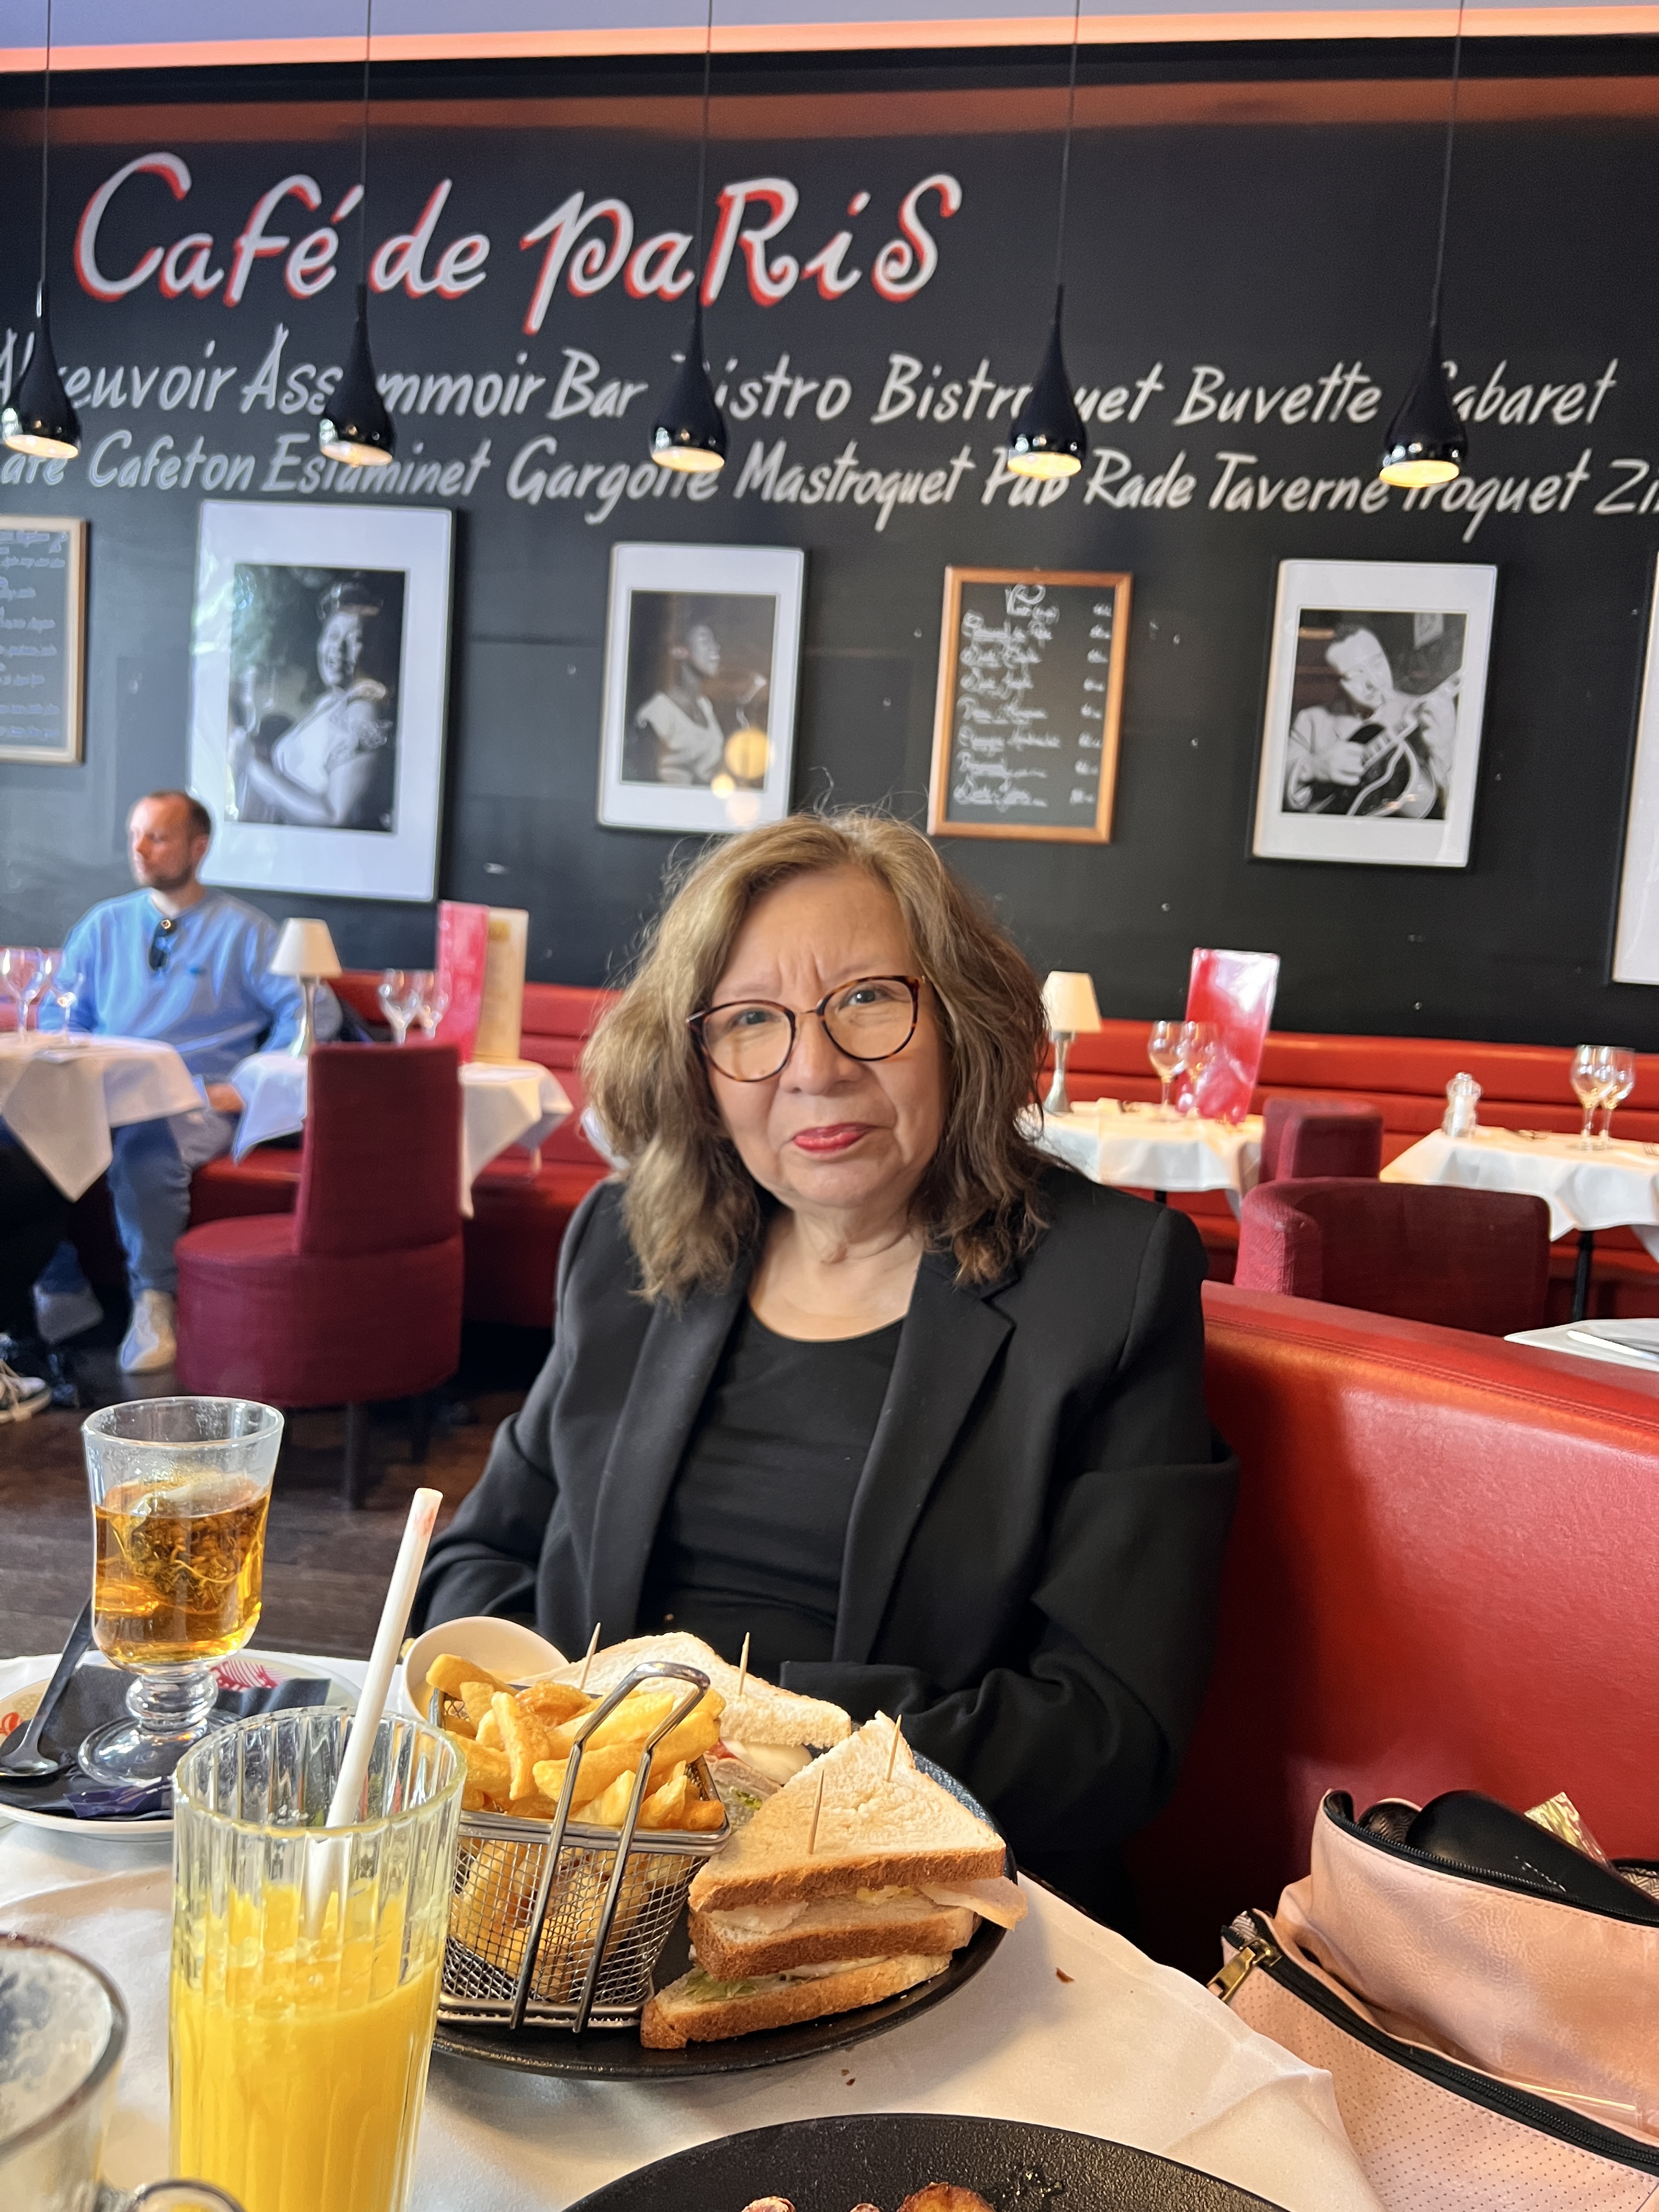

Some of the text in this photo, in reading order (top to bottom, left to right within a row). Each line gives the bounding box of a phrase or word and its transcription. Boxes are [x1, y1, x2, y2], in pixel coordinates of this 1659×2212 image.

[74, 152, 364, 307] Café
[369, 178, 490, 300] de
[0, 323, 1619, 426] Aeuvoir Assmmoir Bar istro Bistruet Buvette abaret
[89, 430, 256, 491] Cafeton
[733, 439, 977, 532] Mastroquet
[1082, 448, 1198, 509] Rade
[1208, 451, 1390, 514] Taverne
